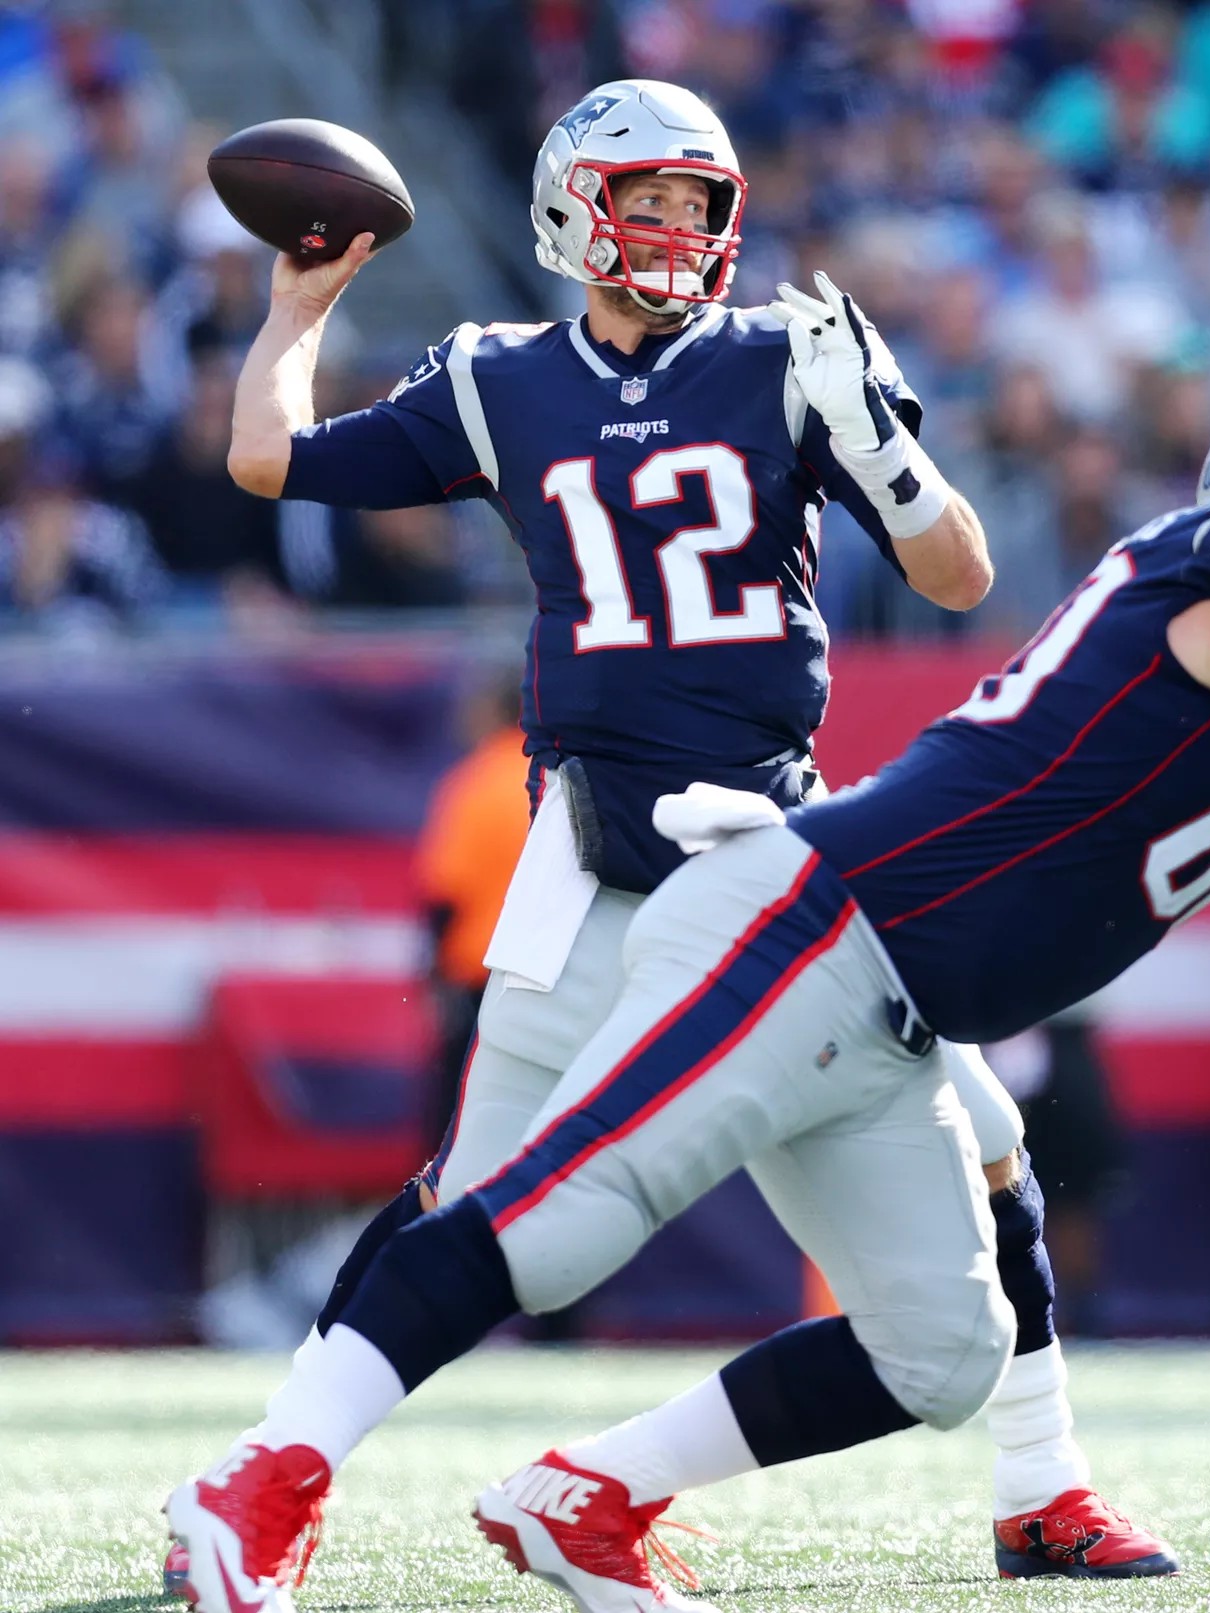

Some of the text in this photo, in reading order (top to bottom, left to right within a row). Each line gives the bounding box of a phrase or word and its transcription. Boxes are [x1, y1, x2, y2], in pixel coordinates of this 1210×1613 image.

[600, 420, 669, 440] PATRIOTS
[540, 441, 789, 655] 12
[501, 1463, 604, 1526] NIKE
